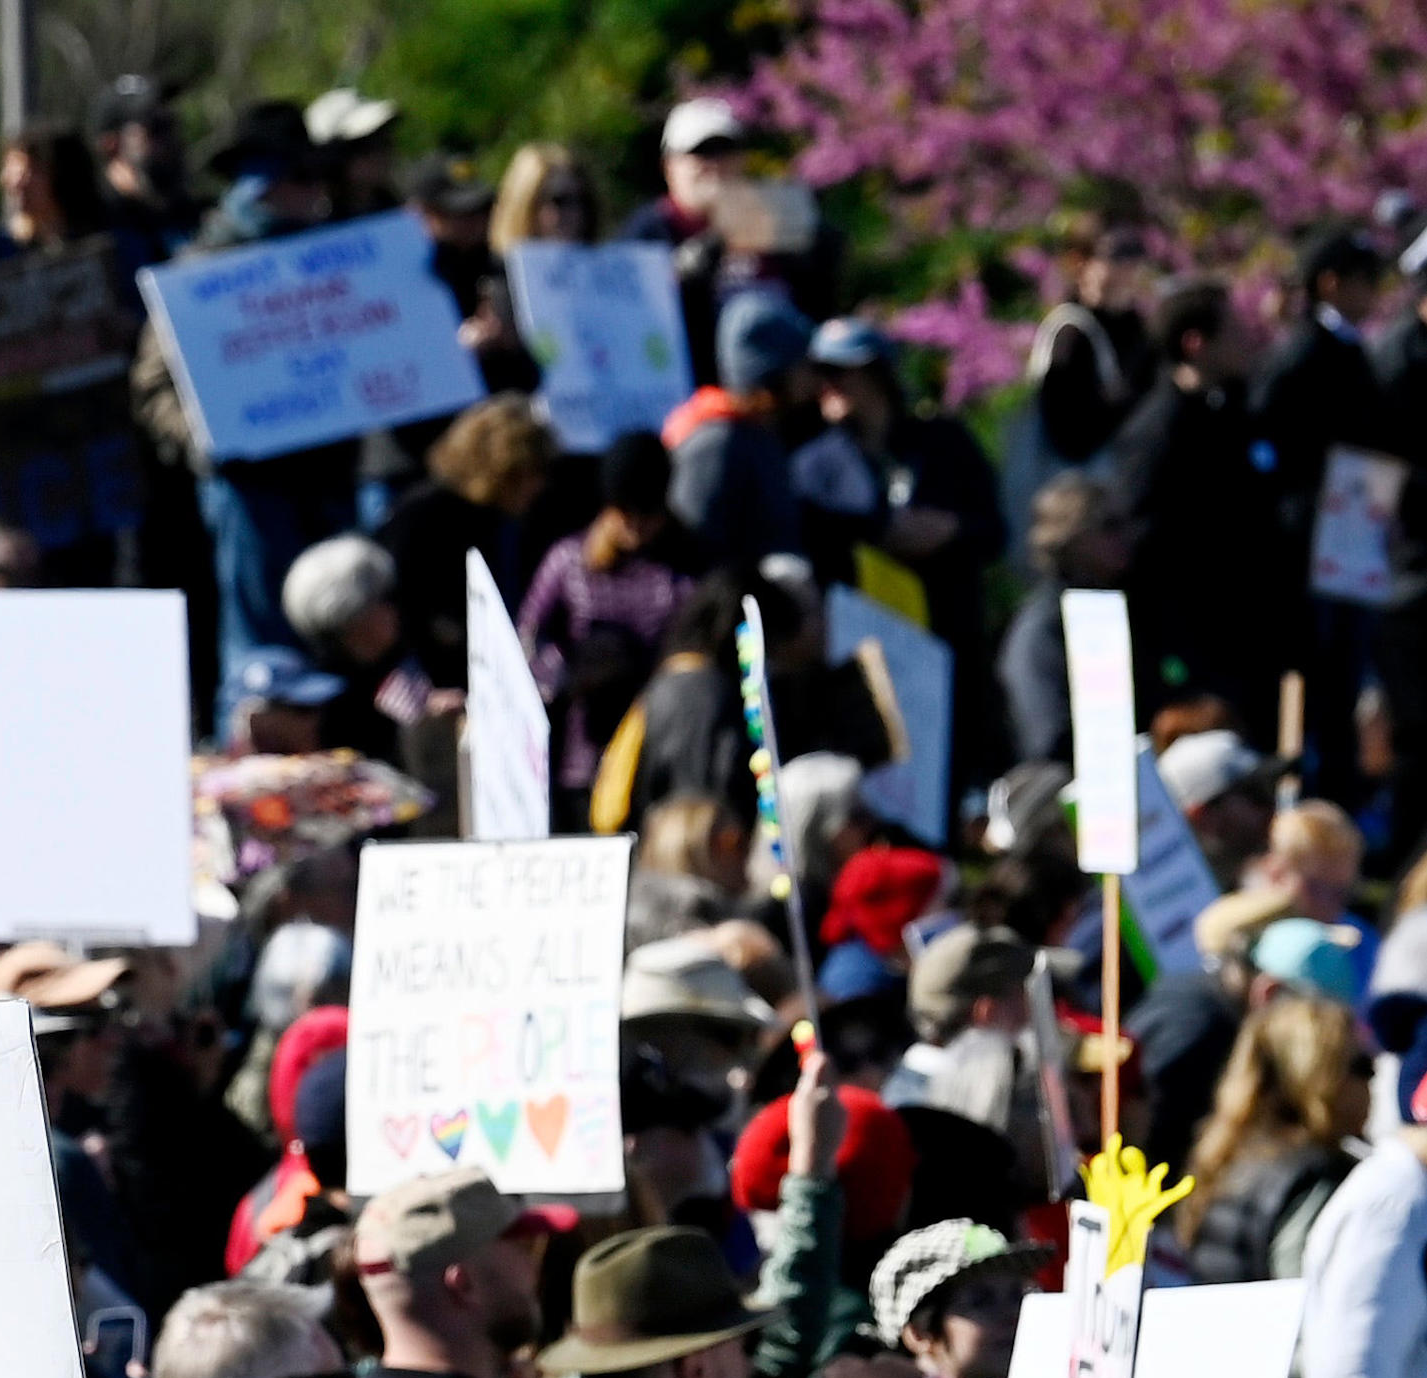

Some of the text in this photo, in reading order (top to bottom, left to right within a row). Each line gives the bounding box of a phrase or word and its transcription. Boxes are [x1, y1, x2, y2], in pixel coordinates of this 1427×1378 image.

[372, 853, 617, 916] WE THE PEOPLE
[366, 927, 599, 1002] MEANS ALL
[361, 999, 615, 1099] THE PEOPLE
